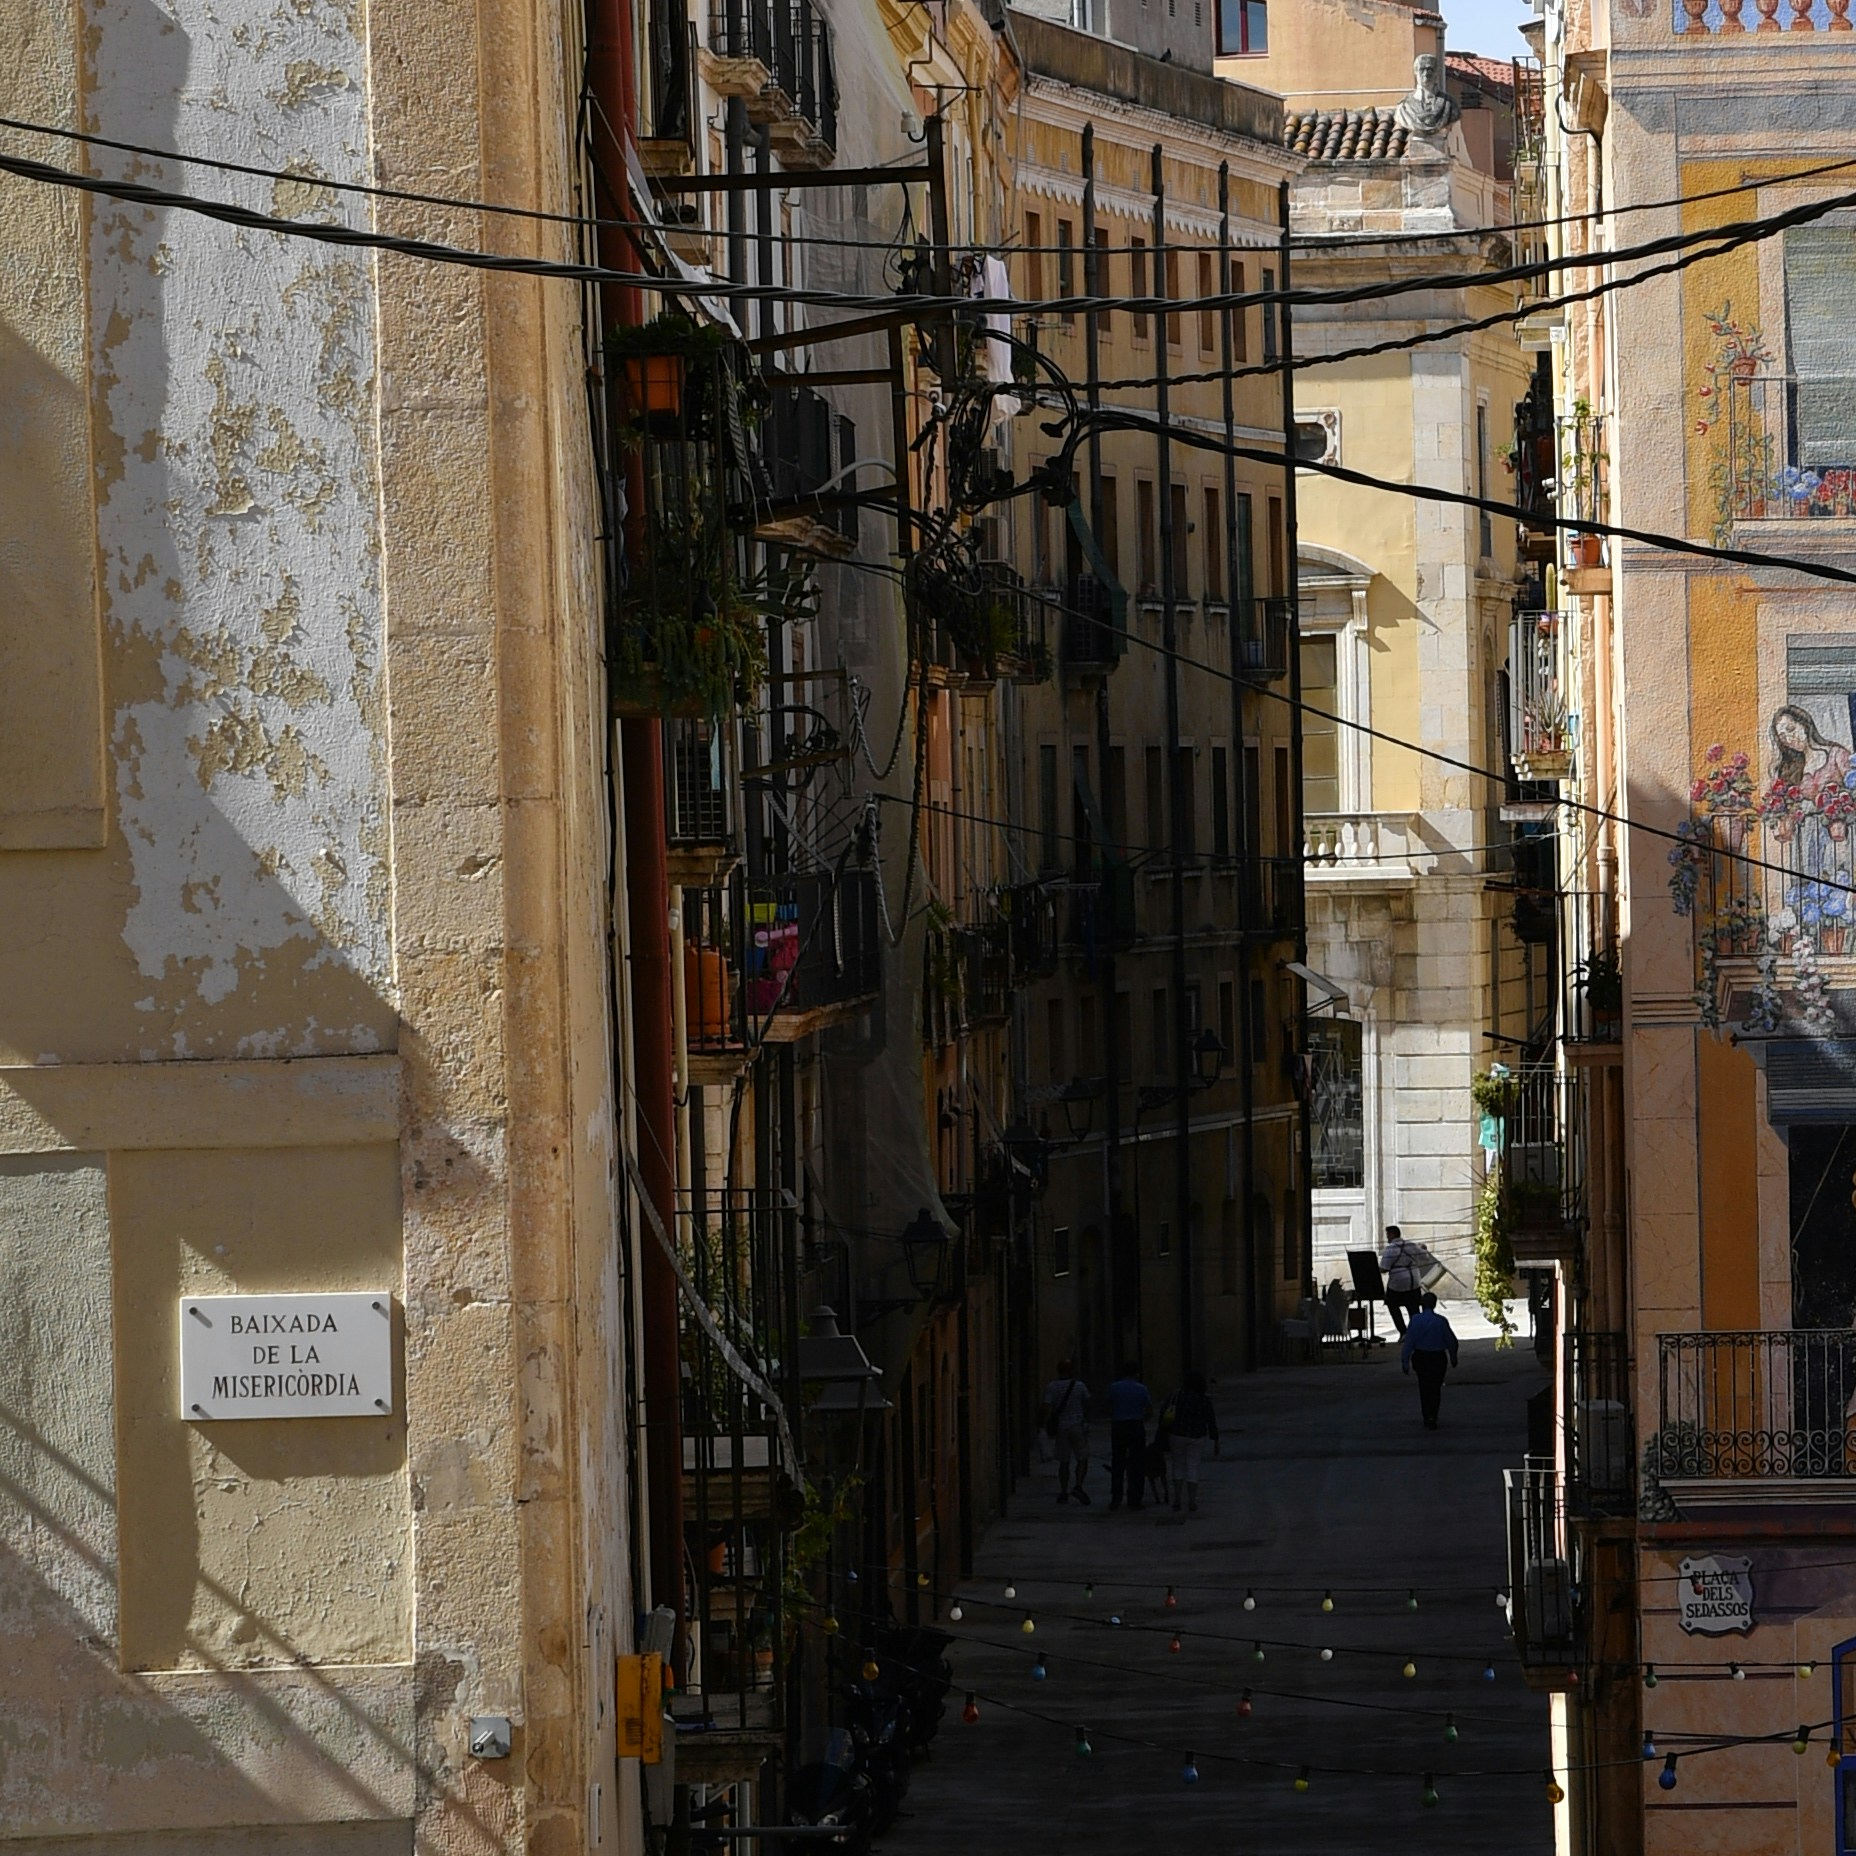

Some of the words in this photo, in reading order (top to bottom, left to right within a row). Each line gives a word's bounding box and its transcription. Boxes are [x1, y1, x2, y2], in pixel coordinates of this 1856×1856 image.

[230, 1313, 338, 1334] BAIXADA
[253, 1345, 280, 1364] DE
[291, 1344, 321, 1364] LA
[211, 1368, 360, 1399] MISERICÒRDIA
[1692, 1570, 1739, 1588] PLAÇA
[1702, 1586, 1734, 1601] DELS
[1686, 1603, 1749, 1619] SEDASSOS
